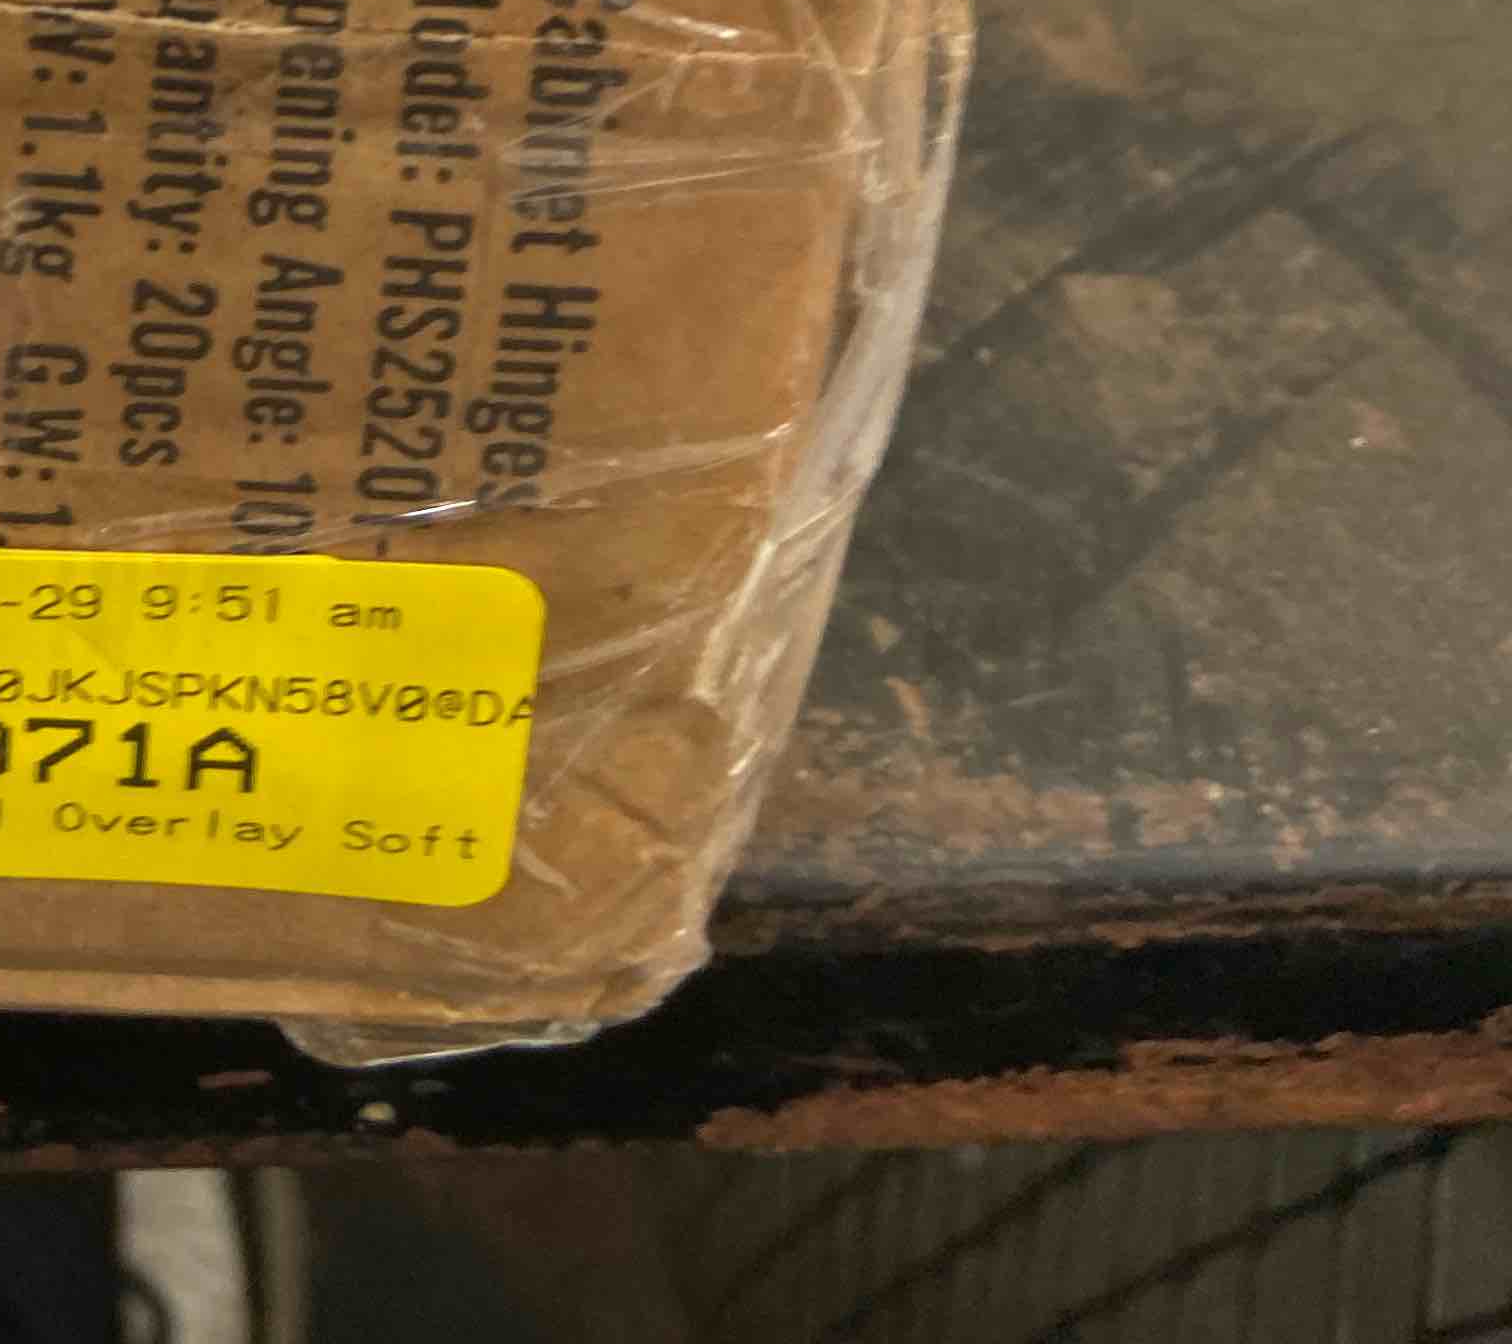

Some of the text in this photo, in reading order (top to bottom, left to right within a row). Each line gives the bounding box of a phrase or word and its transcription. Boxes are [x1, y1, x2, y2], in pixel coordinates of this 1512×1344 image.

[3, 343, 88, 481] G.W:
[109, 279, 218, 467] 20pcs
[232, 253, 344, 445] Angle:
[464, 283, 600, 512] Hinges
[140, 583, 281, 623] 9:51
[328, 602, 402, 630] am
[53, 802, 303, 851] Overlay
[342, 819, 480, 860] Soft
